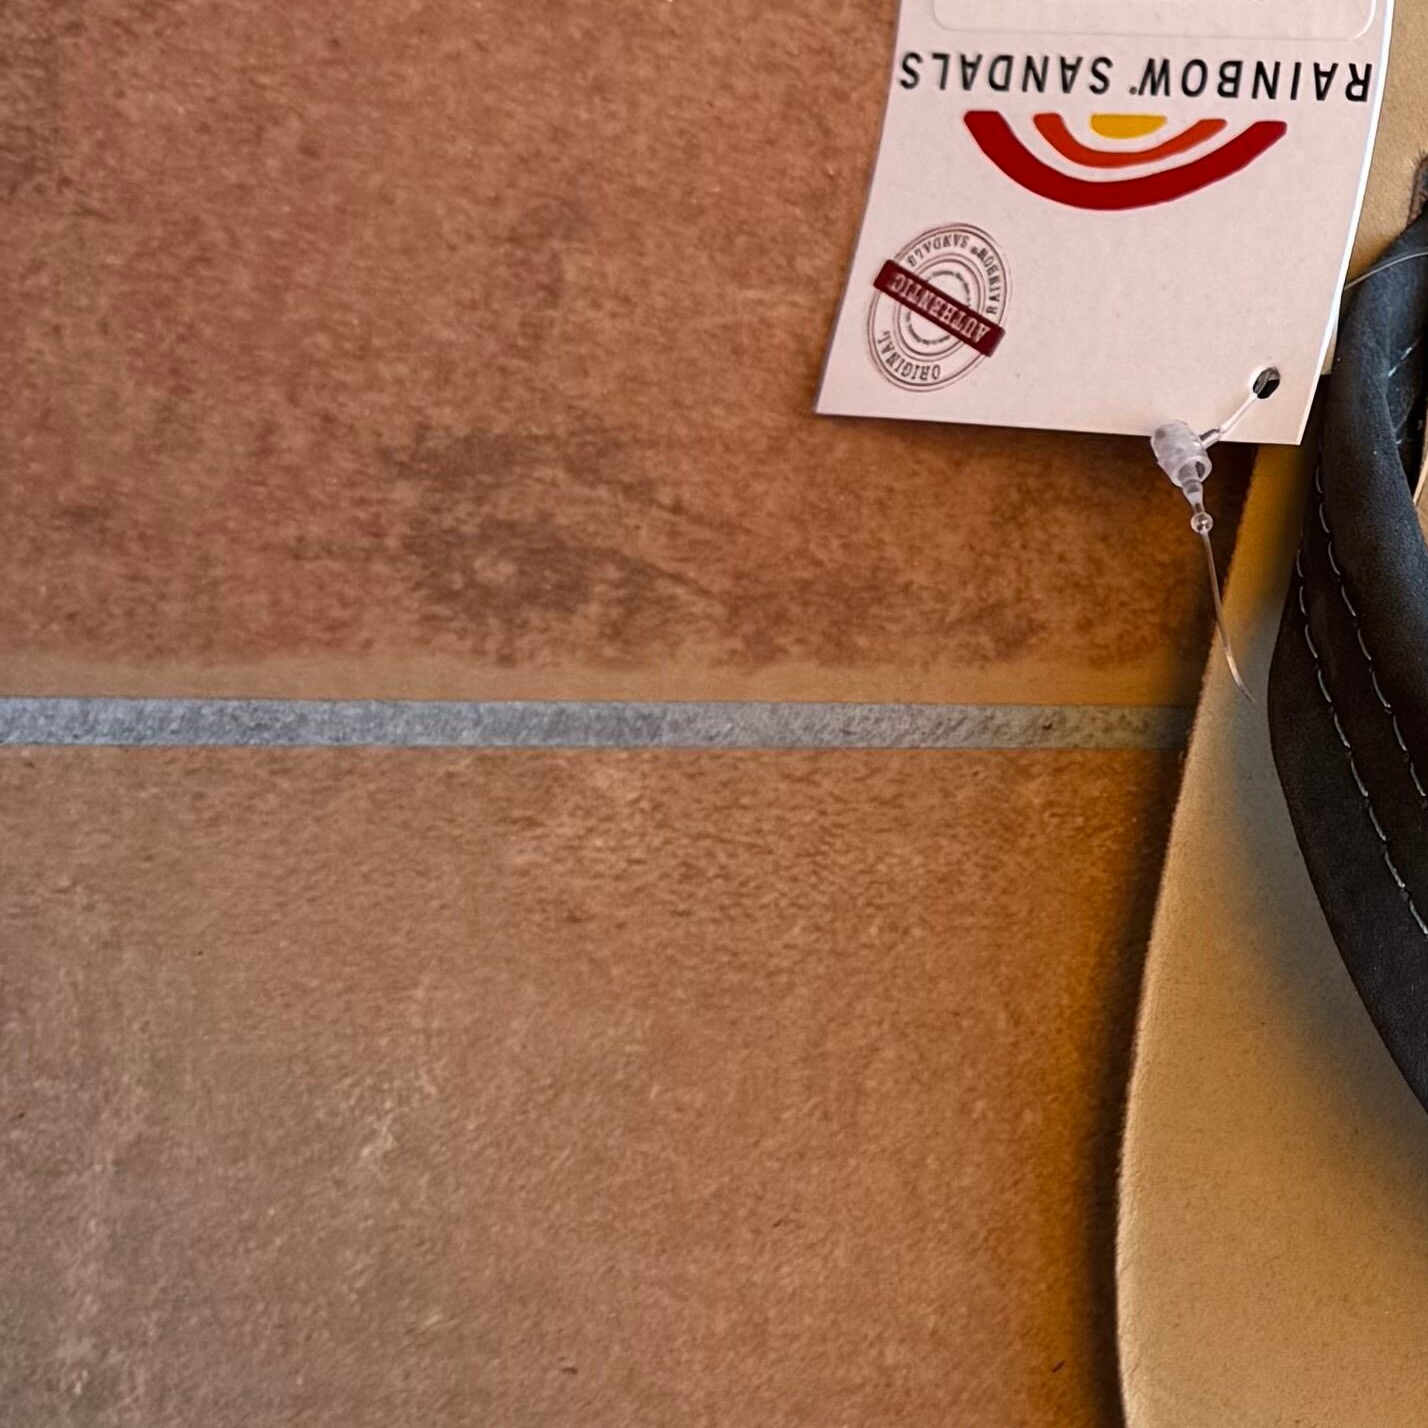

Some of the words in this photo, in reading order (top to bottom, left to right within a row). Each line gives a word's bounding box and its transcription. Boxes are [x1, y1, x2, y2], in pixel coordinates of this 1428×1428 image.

[899, 52, 1114, 94] SANDALS
[907, 233, 971, 268] SANDALS
[889, 272, 992, 344] AUTHENTIC
[877, 330, 941, 381] ORIGINAL
